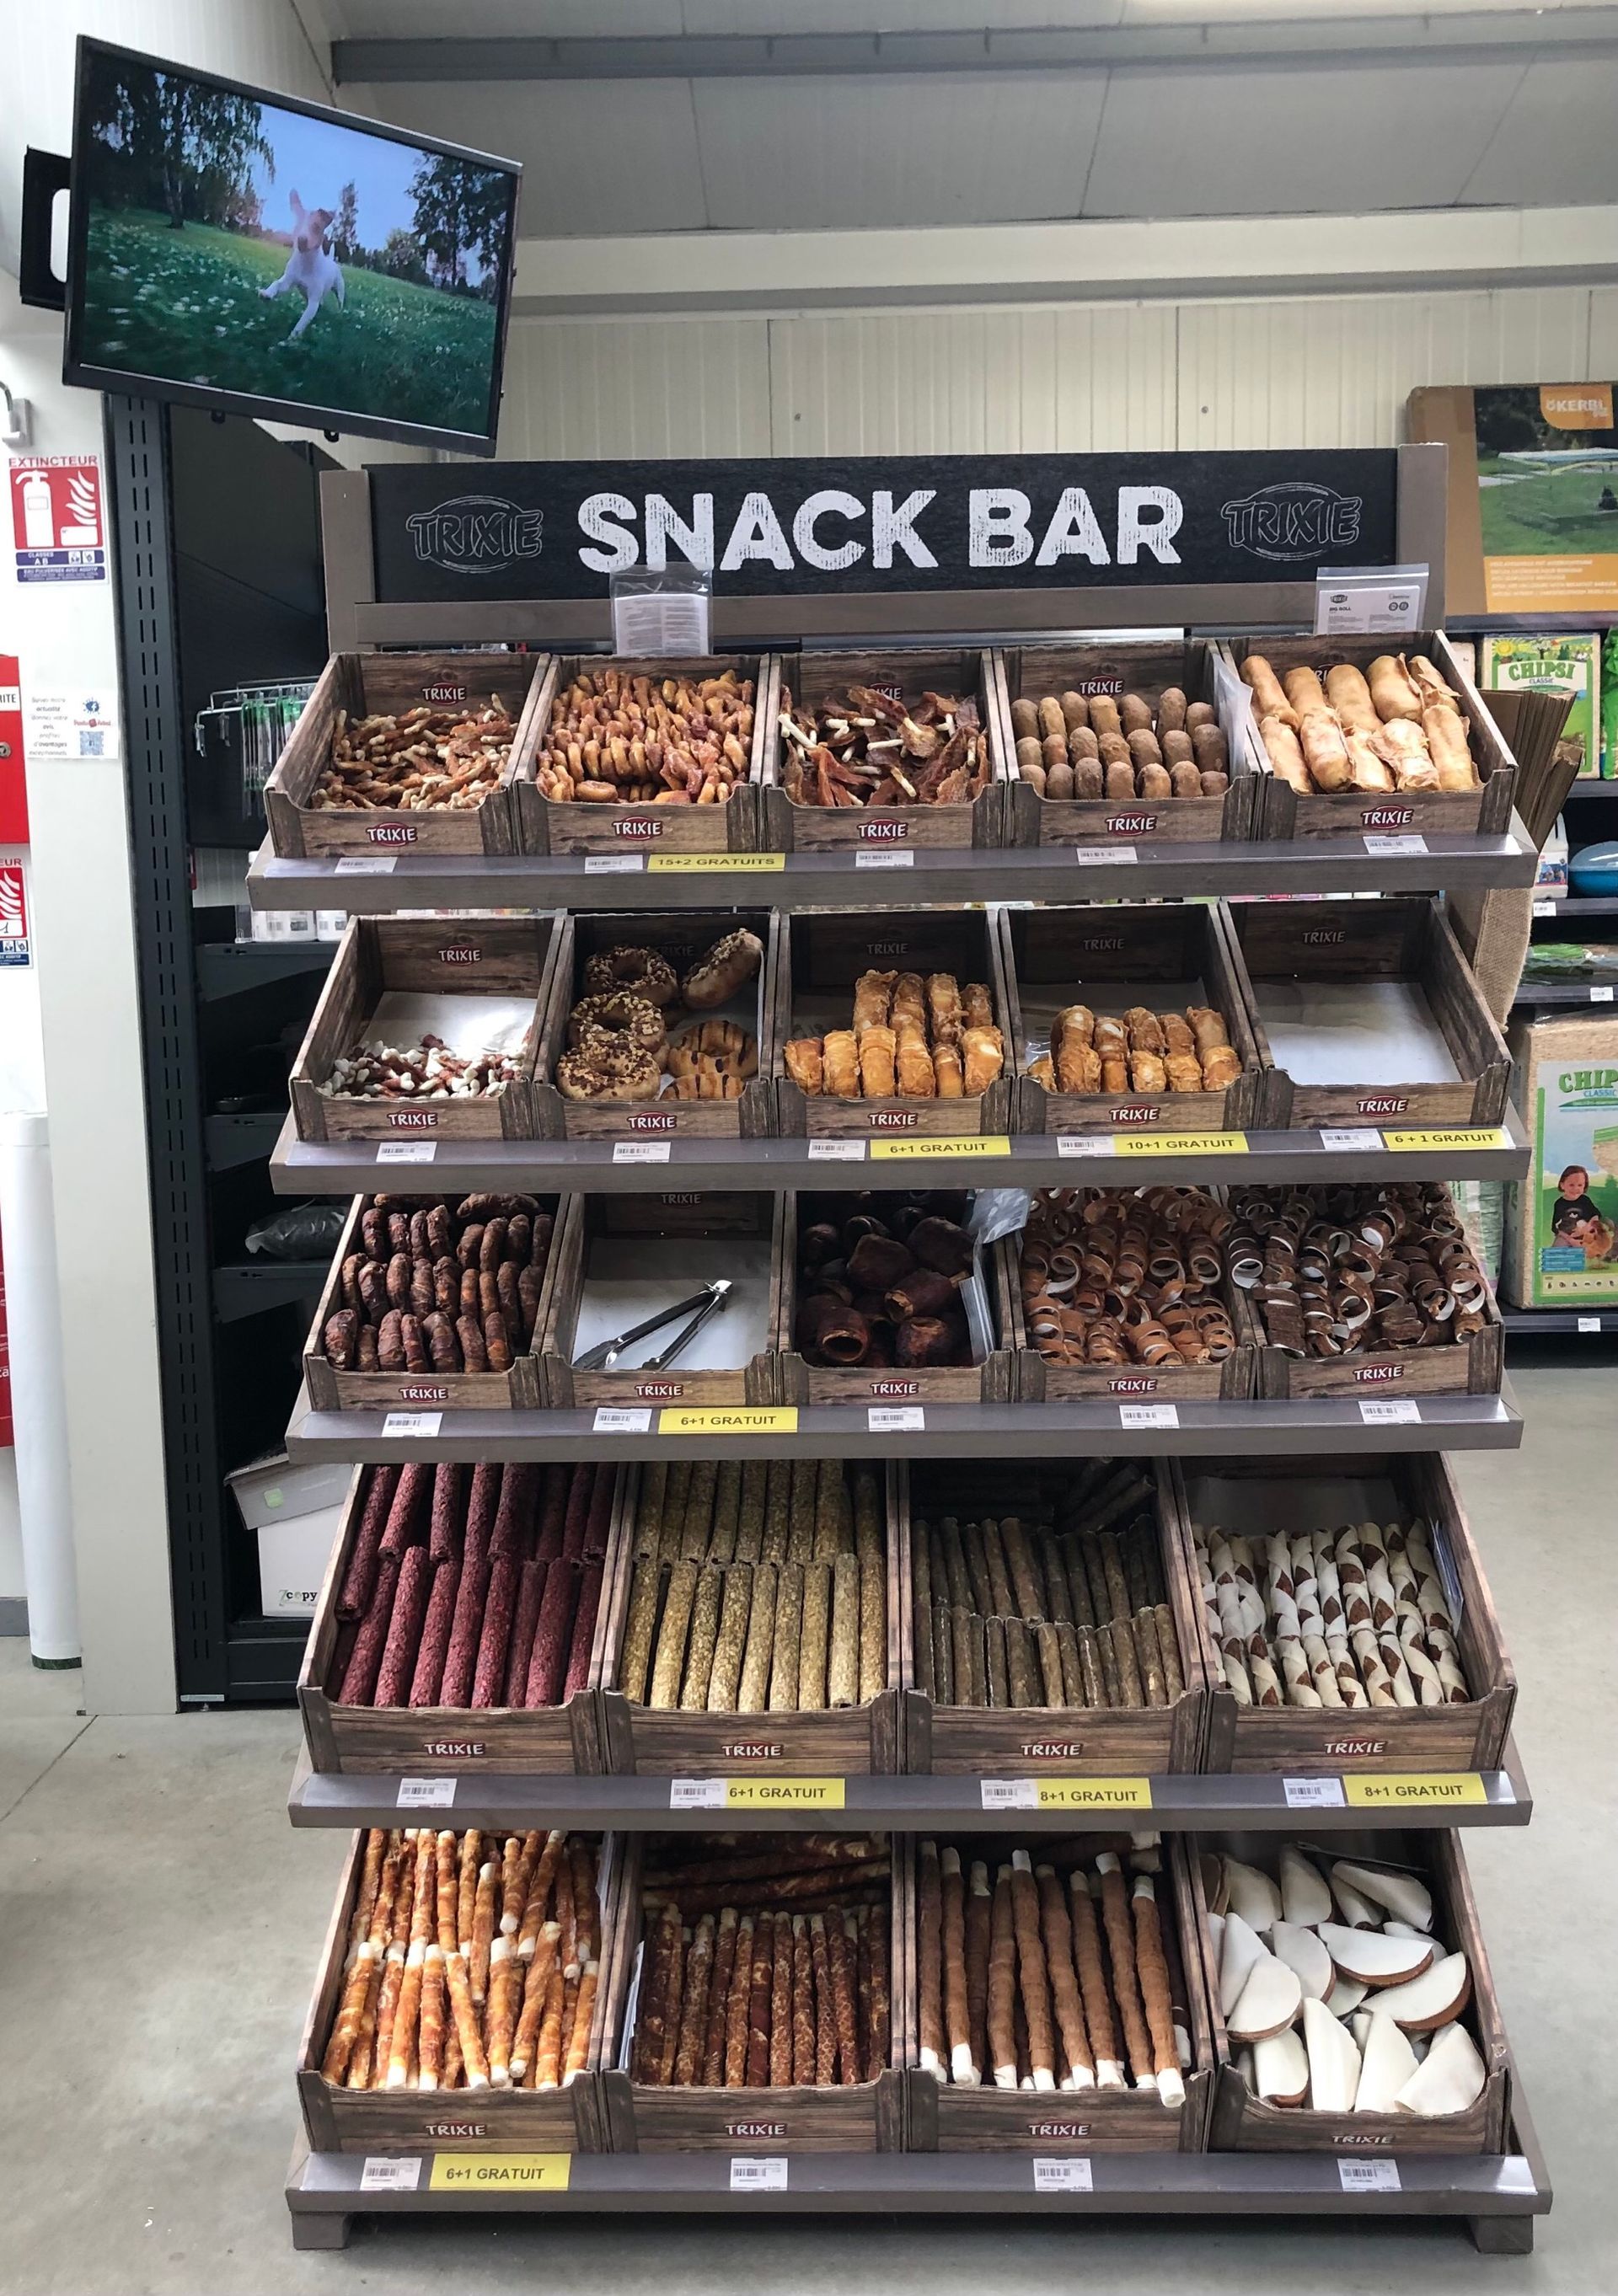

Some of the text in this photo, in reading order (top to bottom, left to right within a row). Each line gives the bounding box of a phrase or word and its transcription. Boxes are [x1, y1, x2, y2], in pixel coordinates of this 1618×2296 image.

[1556, 399, 1603, 412] KERBL
[8, 456, 98, 468] EXTINCTEUR
[1221, 495, 1363, 549] TRIXIE
[405, 509, 544, 559] TRIXIE
[577, 485, 1185, 573] SNACK BAR
[1508, 661, 1576, 681] CHIPSI
[1080, 681, 1122, 694] TRIXIE
[422, 687, 465, 702] TRIXIE
[1363, 810, 1412, 825] TRIXIE
[613, 822, 662, 835] TRIXIE
[859, 824, 907, 838] TRIXIE
[1106, 817, 1155, 832] TRIXIE
[367, 827, 416, 843] TRIXIE
[658, 857, 775, 867] 15+2 GRATUITS
[1303, 931, 1345, 944] TRIXIE
[867, 943, 908, 955] TRIXIE
[1083, 939, 1124, 951] TRIXIE
[438, 949, 480, 962] TRIXIE
[1358, 1100, 1408, 1113] TRIXIE
[388, 1114, 437, 1126] TRIXIE
[869, 1114, 916, 1127] TRIXIE
[1111, 1108, 1159, 1121] TRIXIE
[629, 1116, 675, 1129] TRIXIE
[1127, 1138, 1235, 1150] 10+1 GRATUIT
[1433, 1132, 1494, 1143] GRATUIT
[890, 1142, 988, 1153] 6+1 GRATUIT
[661, 1193, 701, 1204] TRIXIE
[1354, 1367, 1403, 1380] TRIXIE
[635, 1384, 683, 1398] TRIXIE
[871, 1382, 919, 1394] TRIXIE
[1109, 1379, 1157, 1393] TRIXIE
[400, 1388, 447, 1399] TRIXIE
[680, 1415, 776, 1426] 6+1 GRATUIT
[424, 1743, 484, 1756] TRIXIE
[721, 1745, 781, 1757] TRIXIE
[1021, 1744, 1080, 1756] TRIXIE
[1324, 1742, 1385, 1753] TRIXIE
[729, 1786, 754, 1800] 6+1
[758, 1786, 827, 1800] GRATUIT
[1040, 1790, 1065, 1802] 8+1
[1070, 1789, 1138, 1802] GRATUIT
[1364, 1784, 1463, 1797] 8+1 GRATUIT
[426, 2123, 485, 2137] TRIXIE
[725, 2123, 785, 2137] TRIXIE
[1029, 2124, 1089, 2136] TRIXIE
[1333, 2135, 1391, 2143] TRIXIE
[446, 2167, 544, 2181] 6+1 GRATUIT
